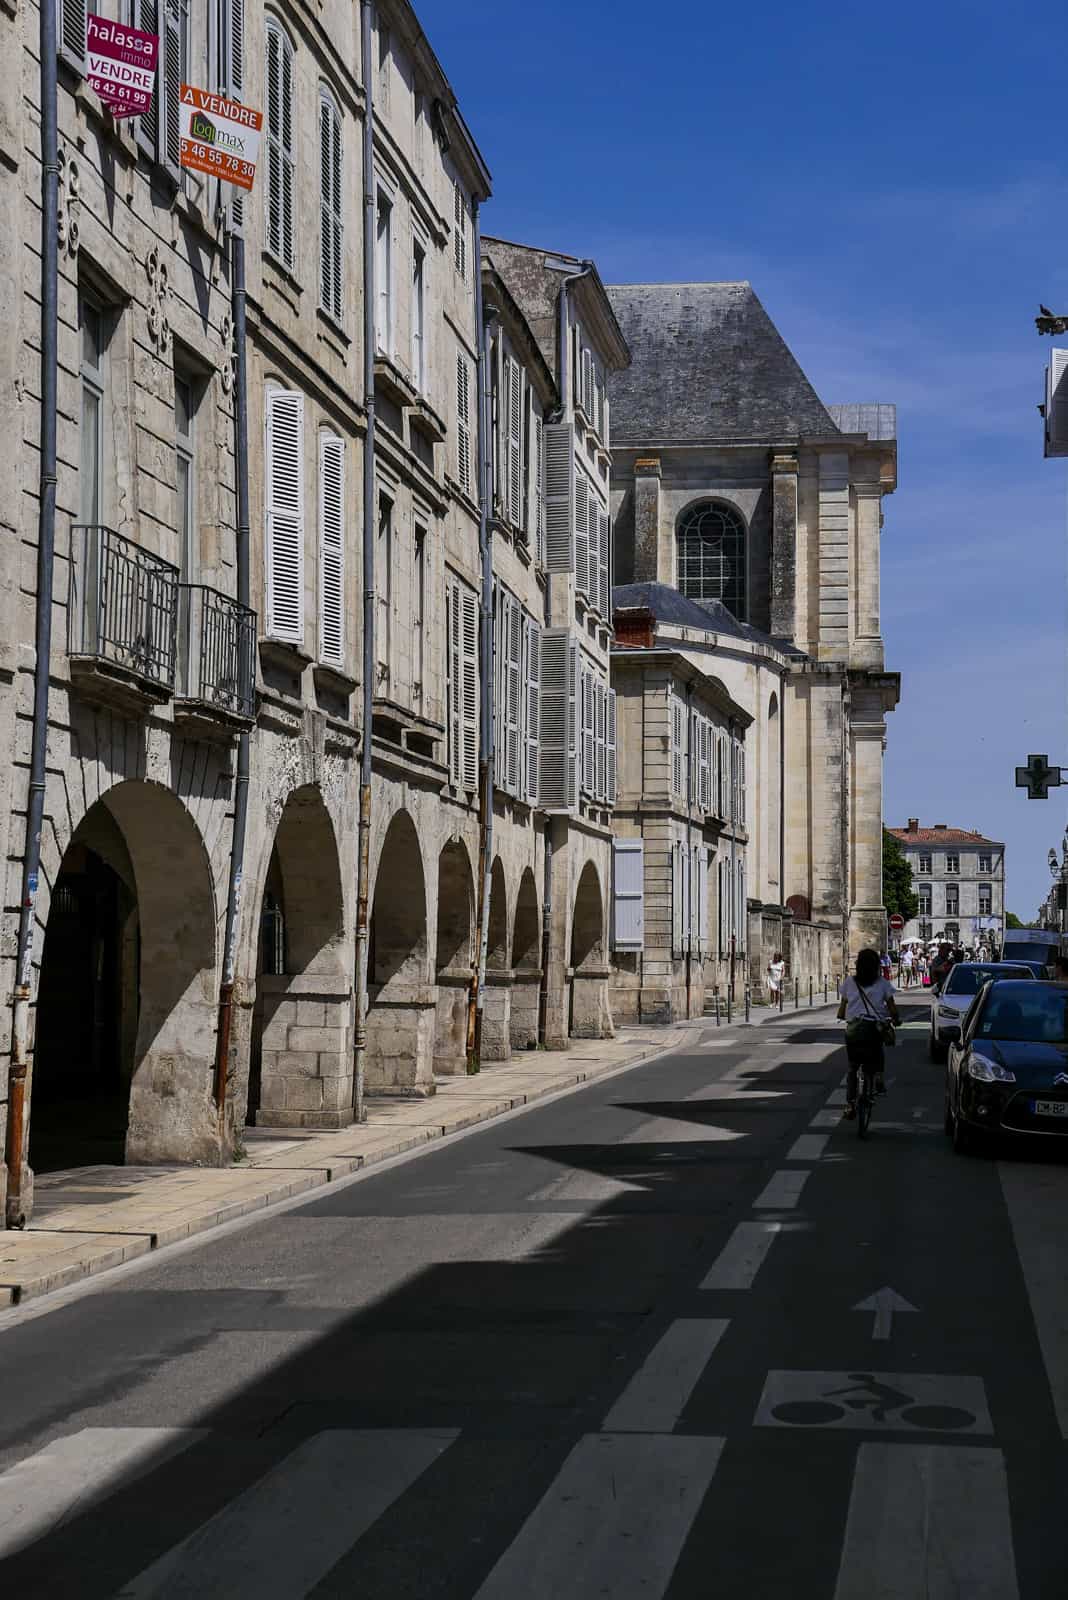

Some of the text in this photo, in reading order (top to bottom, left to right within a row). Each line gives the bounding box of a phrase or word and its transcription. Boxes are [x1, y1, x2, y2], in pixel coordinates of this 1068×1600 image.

[89, 57, 152, 88] VENDRE
[120, 50, 151, 68] immo
[103, 82, 116, 95] 42
[118, 87, 130, 100] 61
[134, 92, 146, 104] 99
[183, 89, 257, 127] A VENDRE
[181, 139, 188, 152] 5
[191, 144, 206, 158] 46
[208, 150, 222, 165] 55
[226, 155, 239, 171] 78
[241, 162, 254, 177] 30
